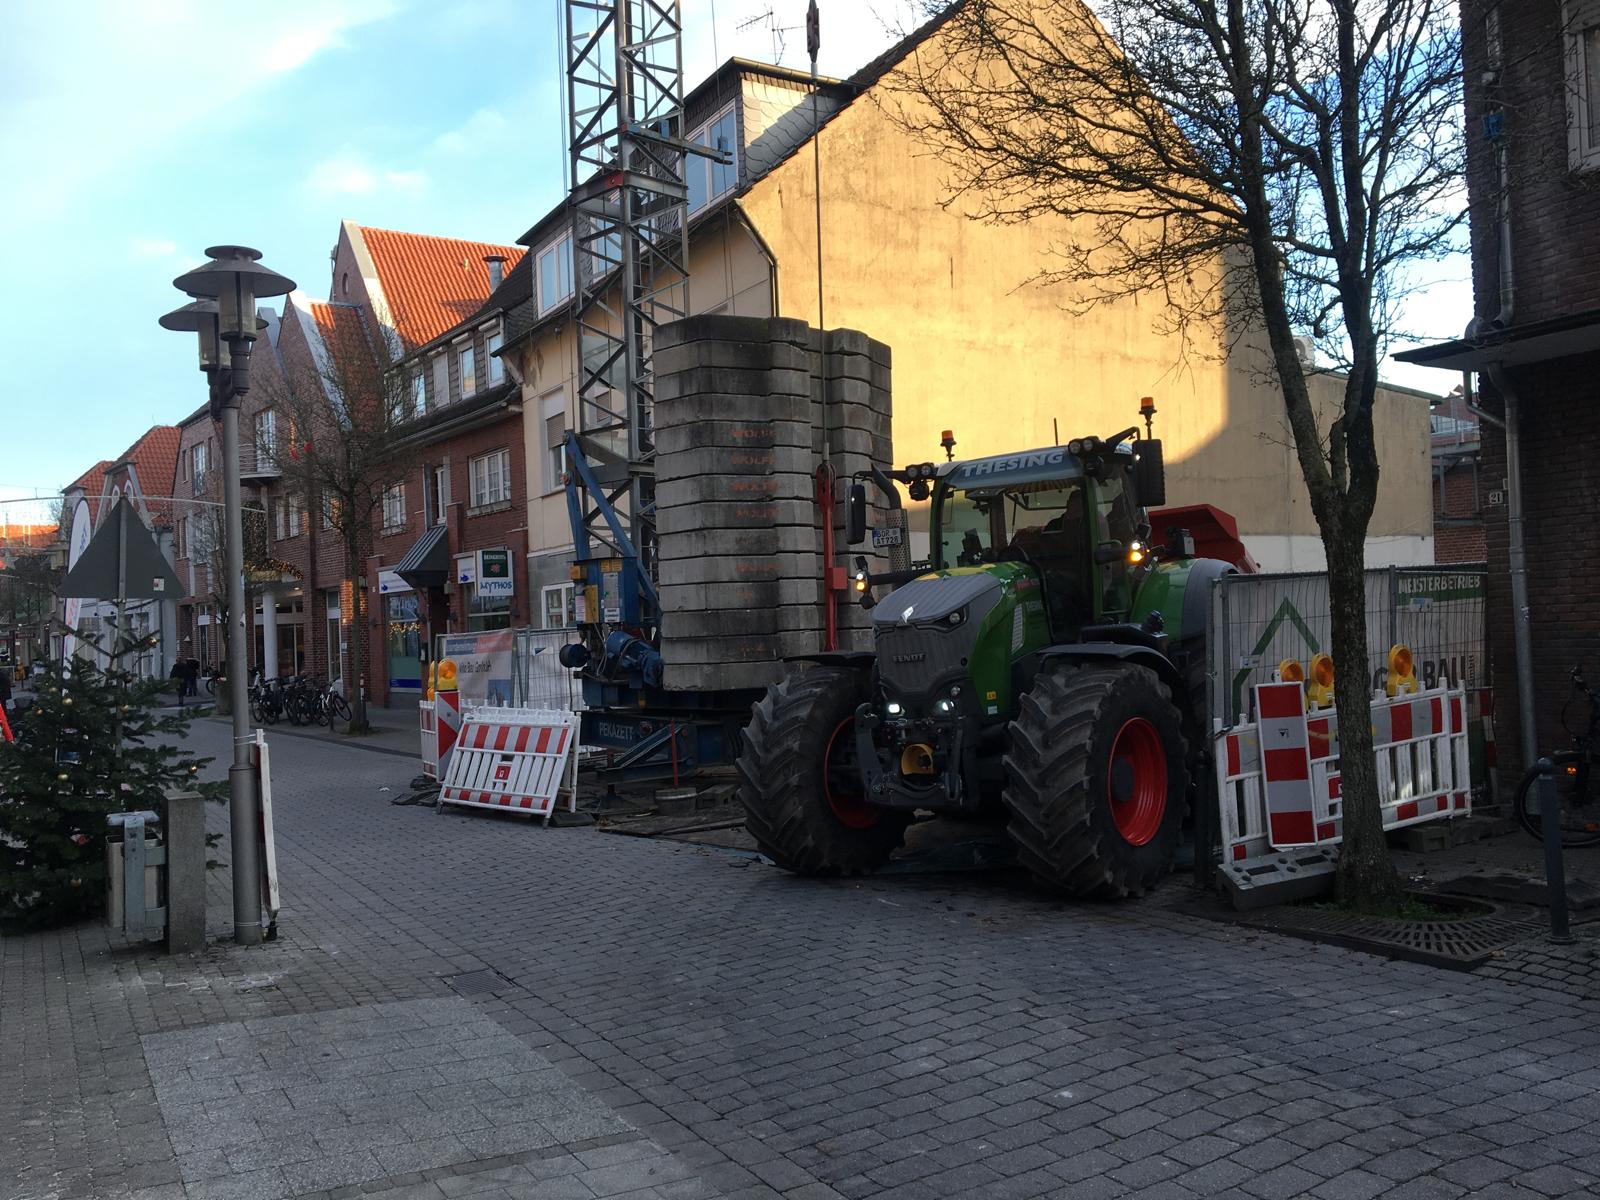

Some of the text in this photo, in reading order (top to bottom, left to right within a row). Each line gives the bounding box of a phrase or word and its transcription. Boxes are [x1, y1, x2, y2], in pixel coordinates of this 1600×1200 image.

[962, 452, 1064, 477] THESING
[1490, 492, 1501, 503] 21
[480, 581, 512, 593] MYTHOS
[1398, 575, 1481, 593] MEISTERBETRIEB
[892, 653, 925, 662] FENDT
[599, 721, 634, 740] PEKAZETT
